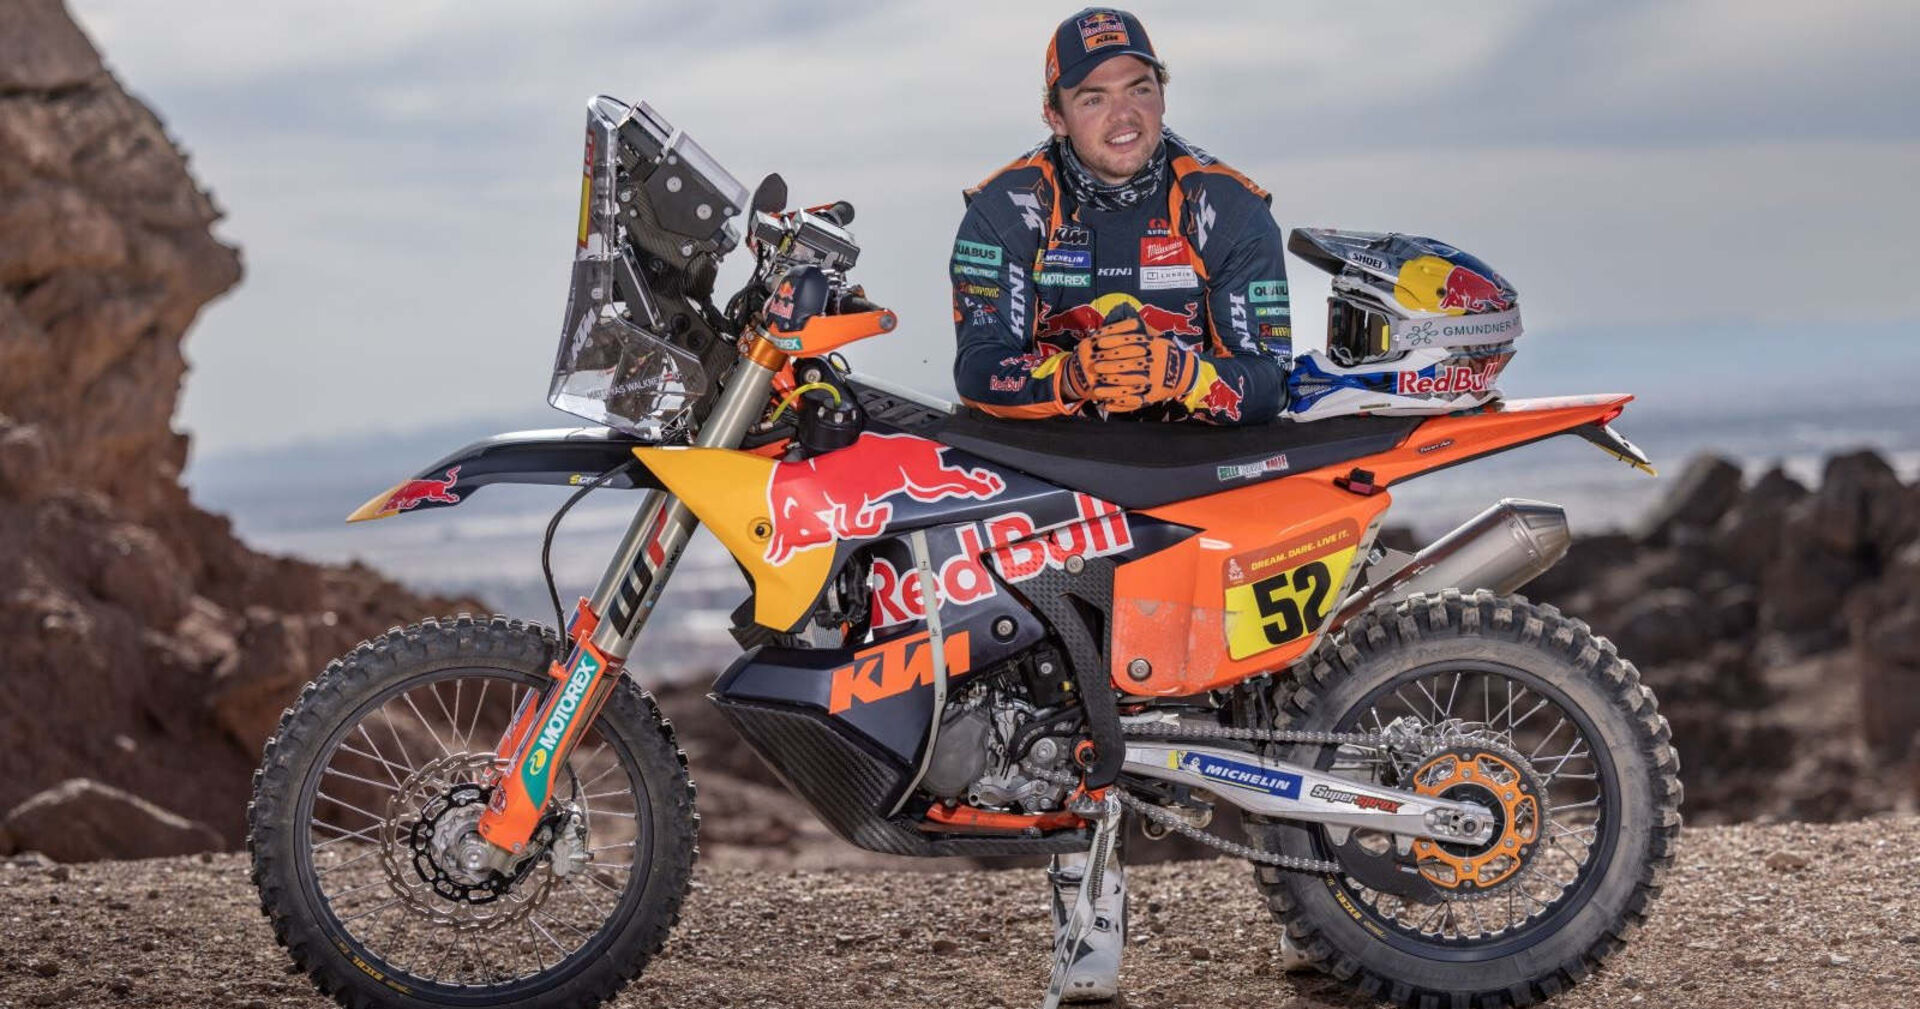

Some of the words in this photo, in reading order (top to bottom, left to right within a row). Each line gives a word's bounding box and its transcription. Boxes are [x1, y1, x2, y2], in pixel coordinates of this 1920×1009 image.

[956, 244, 997, 260] UABUS
[1050, 225, 1090, 247] KTM
[1351, 252, 1383, 270] SHOEI
[1443, 321, 1512, 337] GMUNDNER
[1397, 365, 1453, 395] Red
[1454, 362, 1499, 391] Bull
[872, 522, 997, 629] Red
[985, 491, 1134, 585] Bull
[1251, 555, 1287, 571] DREAM.
[1288, 543, 1316, 559] DARE.
[1317, 533, 1337, 548] LIVE
[1338, 529, 1350, 541] IT.
[1252, 561, 1331, 645] 52
[829, 630, 971, 715] KTM
[539, 656, 598, 751] MOTOREX
[1204, 763, 1290, 791] MICHELIN
